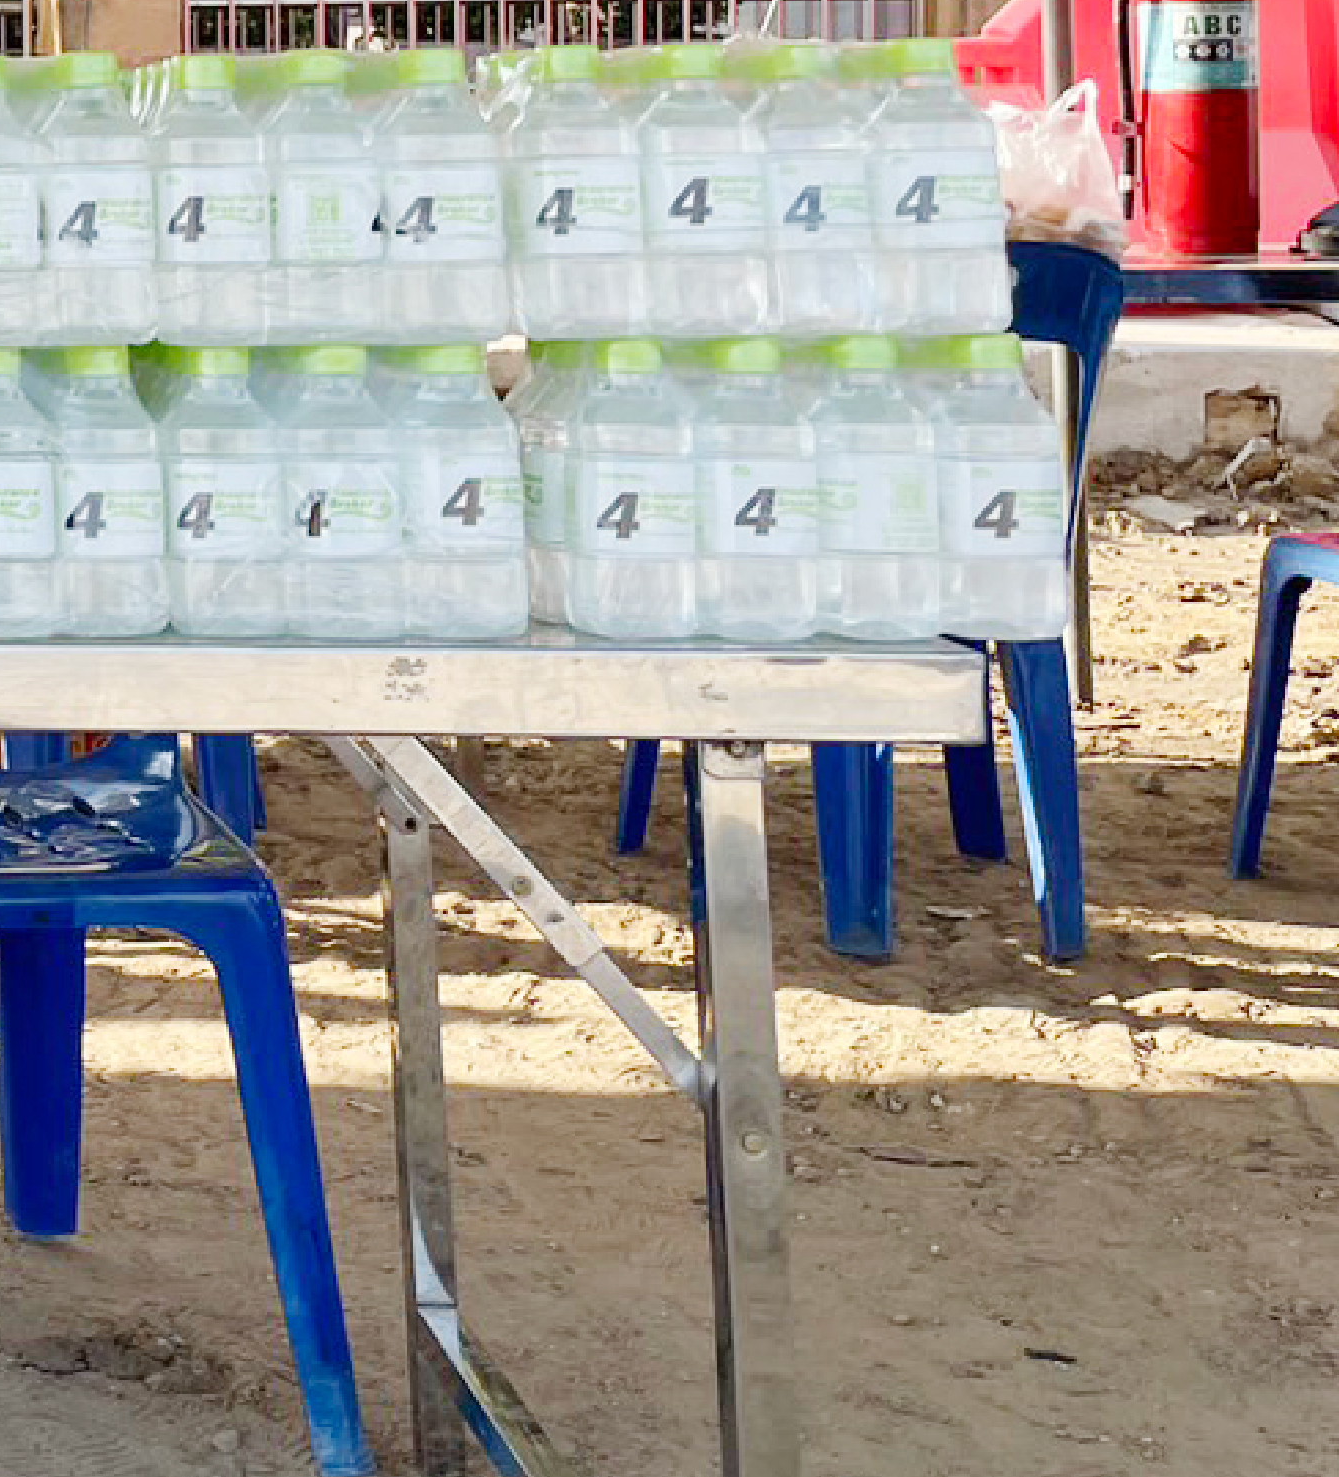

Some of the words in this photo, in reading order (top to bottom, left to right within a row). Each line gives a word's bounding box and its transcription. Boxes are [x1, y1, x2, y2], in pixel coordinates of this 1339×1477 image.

[1183, 14, 1242, 36] ABC
[168, 196, 205, 242] 4
[396, 196, 437, 243] 4
[536, 187, 577, 234] 4
[668, 177, 712, 226] 4
[783, 185, 827, 232] 4
[896, 176, 939, 223] 4
[59, 201, 98, 247] 4
[65, 491, 106, 538] 4
[177, 492, 215, 538] 4
[442, 478, 484, 525] 4
[596, 491, 640, 538] 4
[734, 488, 777, 536] 4
[974, 491, 1019, 538] 4
